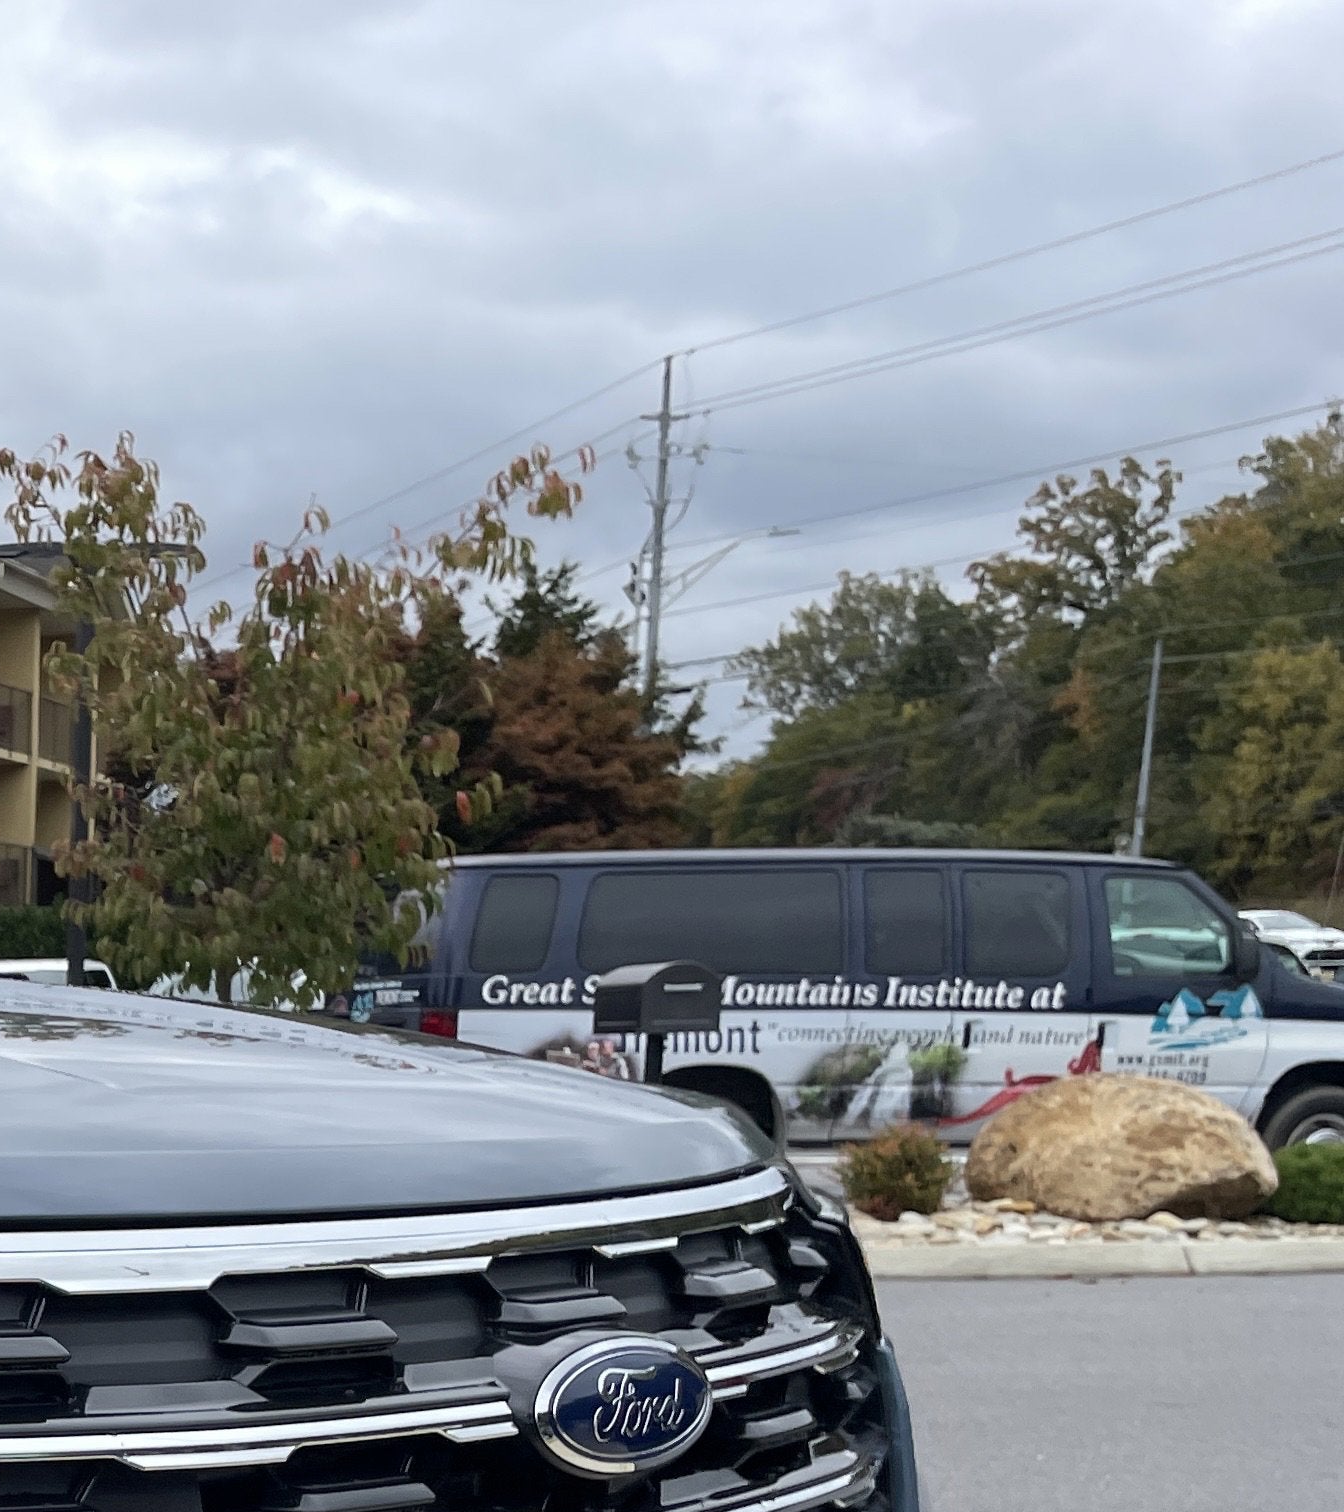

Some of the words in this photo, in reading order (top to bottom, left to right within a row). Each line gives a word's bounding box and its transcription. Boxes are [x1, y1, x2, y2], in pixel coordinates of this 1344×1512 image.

[481, 974, 576, 1006] Great
[884, 975, 1025, 1010] Institute
[1029, 980, 1067, 1010] at
[593, 1365, 685, 1443] Ford
